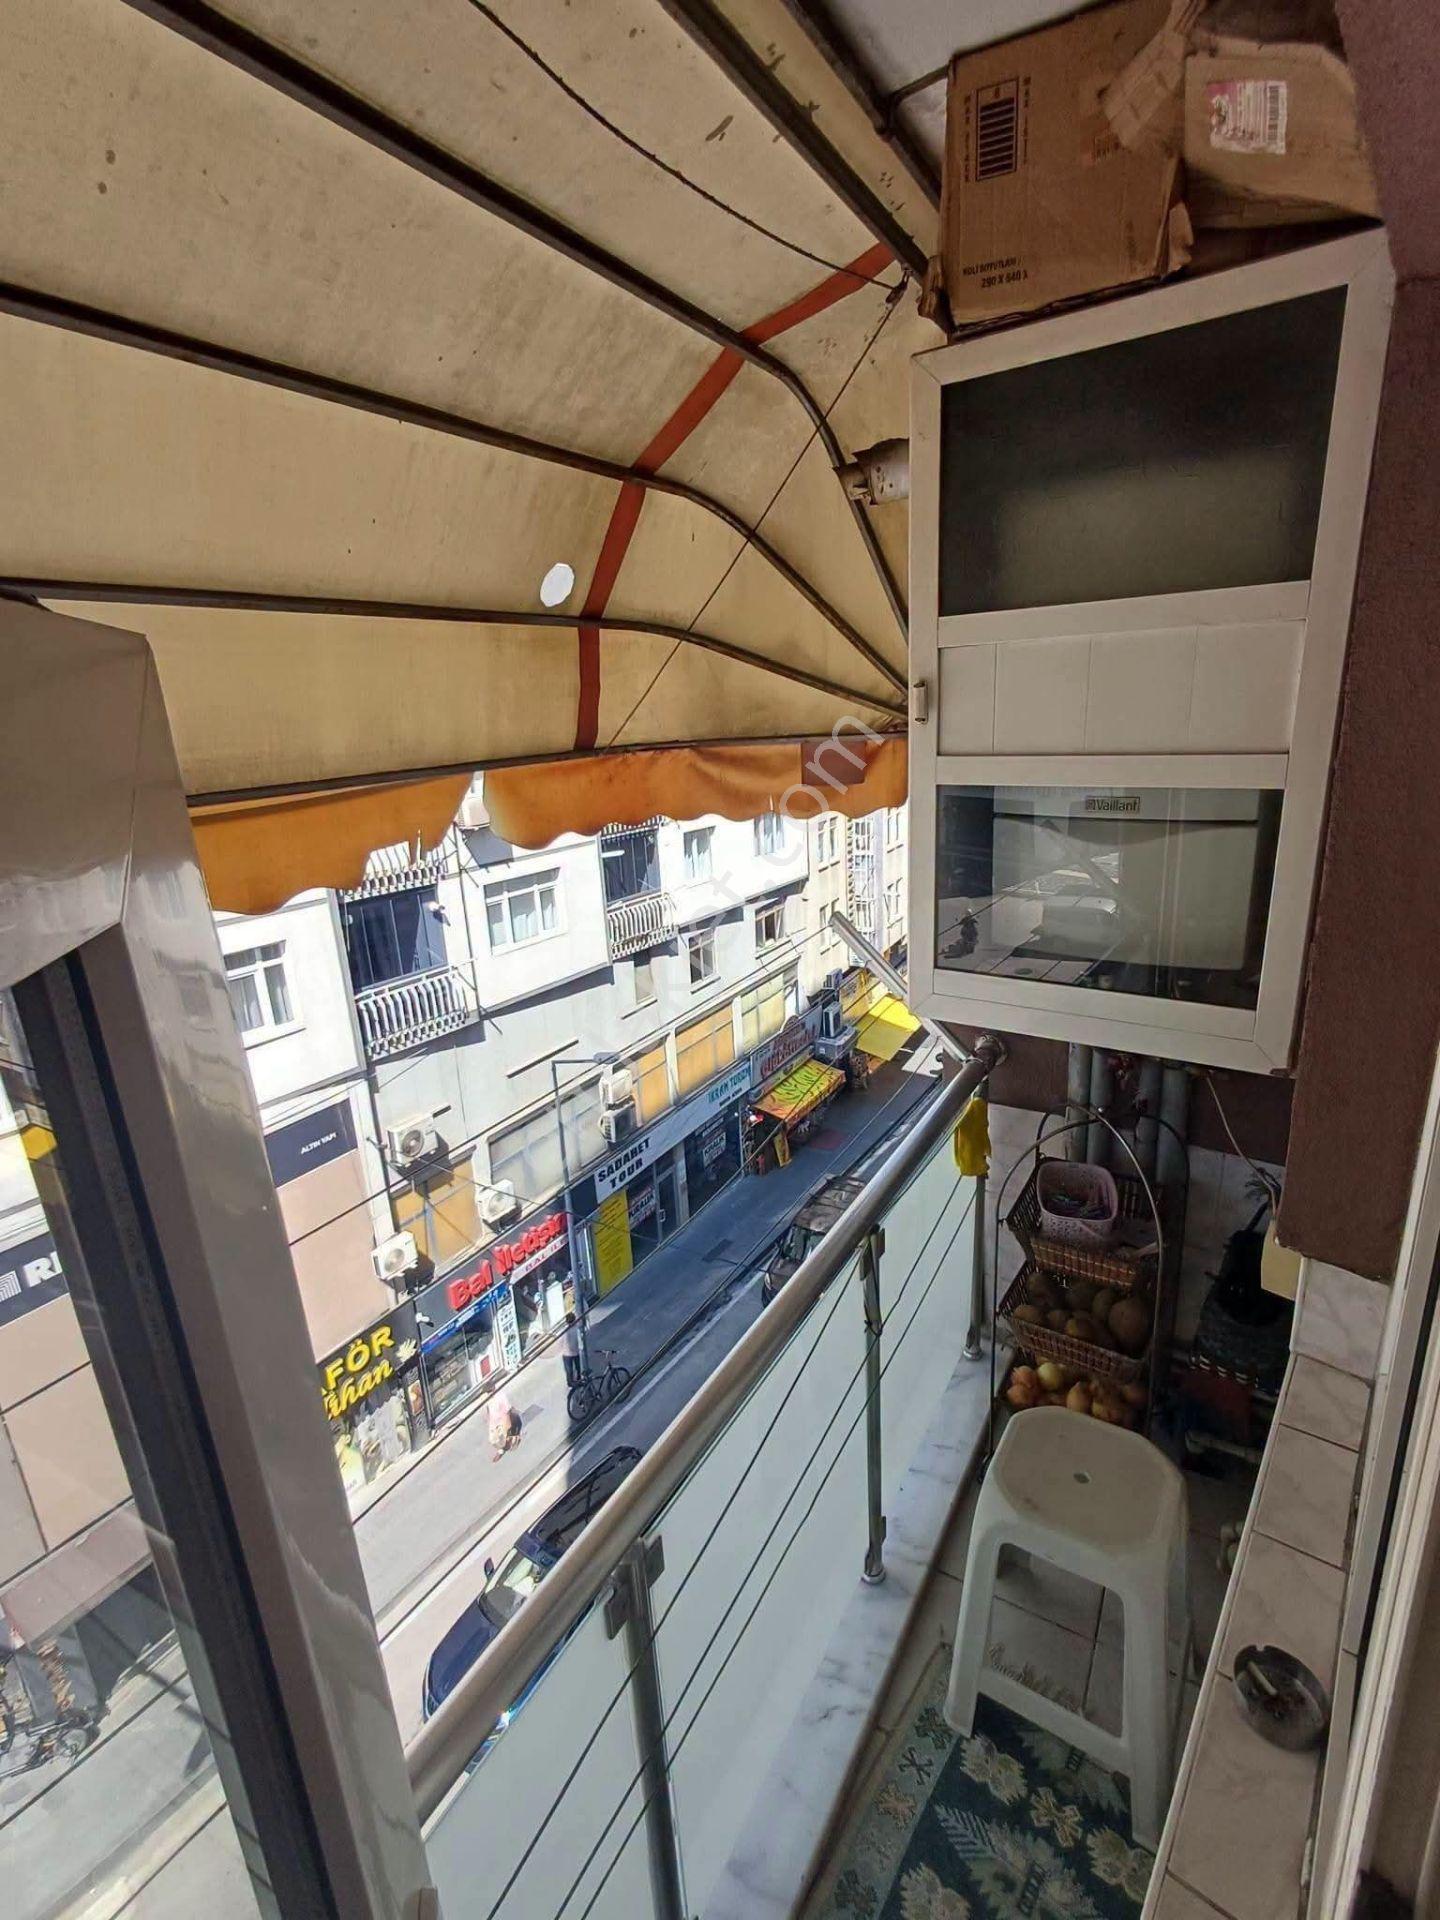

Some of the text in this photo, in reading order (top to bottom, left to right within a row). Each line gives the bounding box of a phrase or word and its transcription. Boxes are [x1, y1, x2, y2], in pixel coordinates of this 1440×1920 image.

[1095, 798, 1138, 811] Vaillant
[610, 1158, 643, 1188] TOUR
[448, 1259, 493, 1311] Bal
